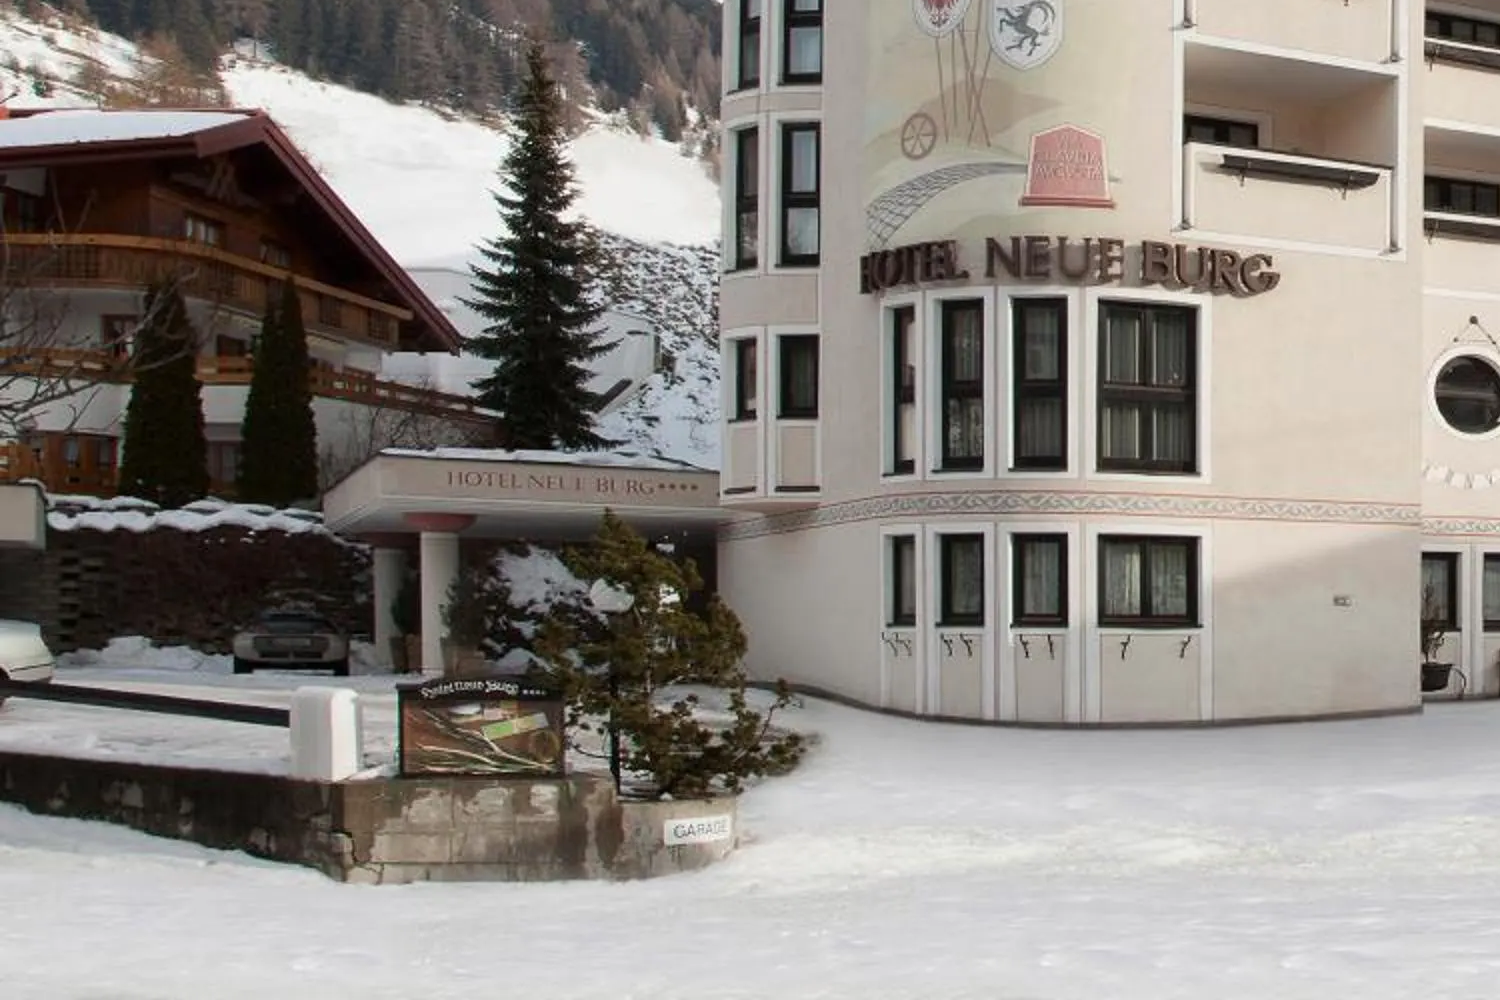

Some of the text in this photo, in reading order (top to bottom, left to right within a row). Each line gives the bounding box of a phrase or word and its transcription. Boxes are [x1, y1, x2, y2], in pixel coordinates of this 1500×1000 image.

[859, 235, 1281, 298] HOTEL NEUE BURG
[447, 471, 523, 489] HOTEL
[596, 478, 655, 495] BURG
